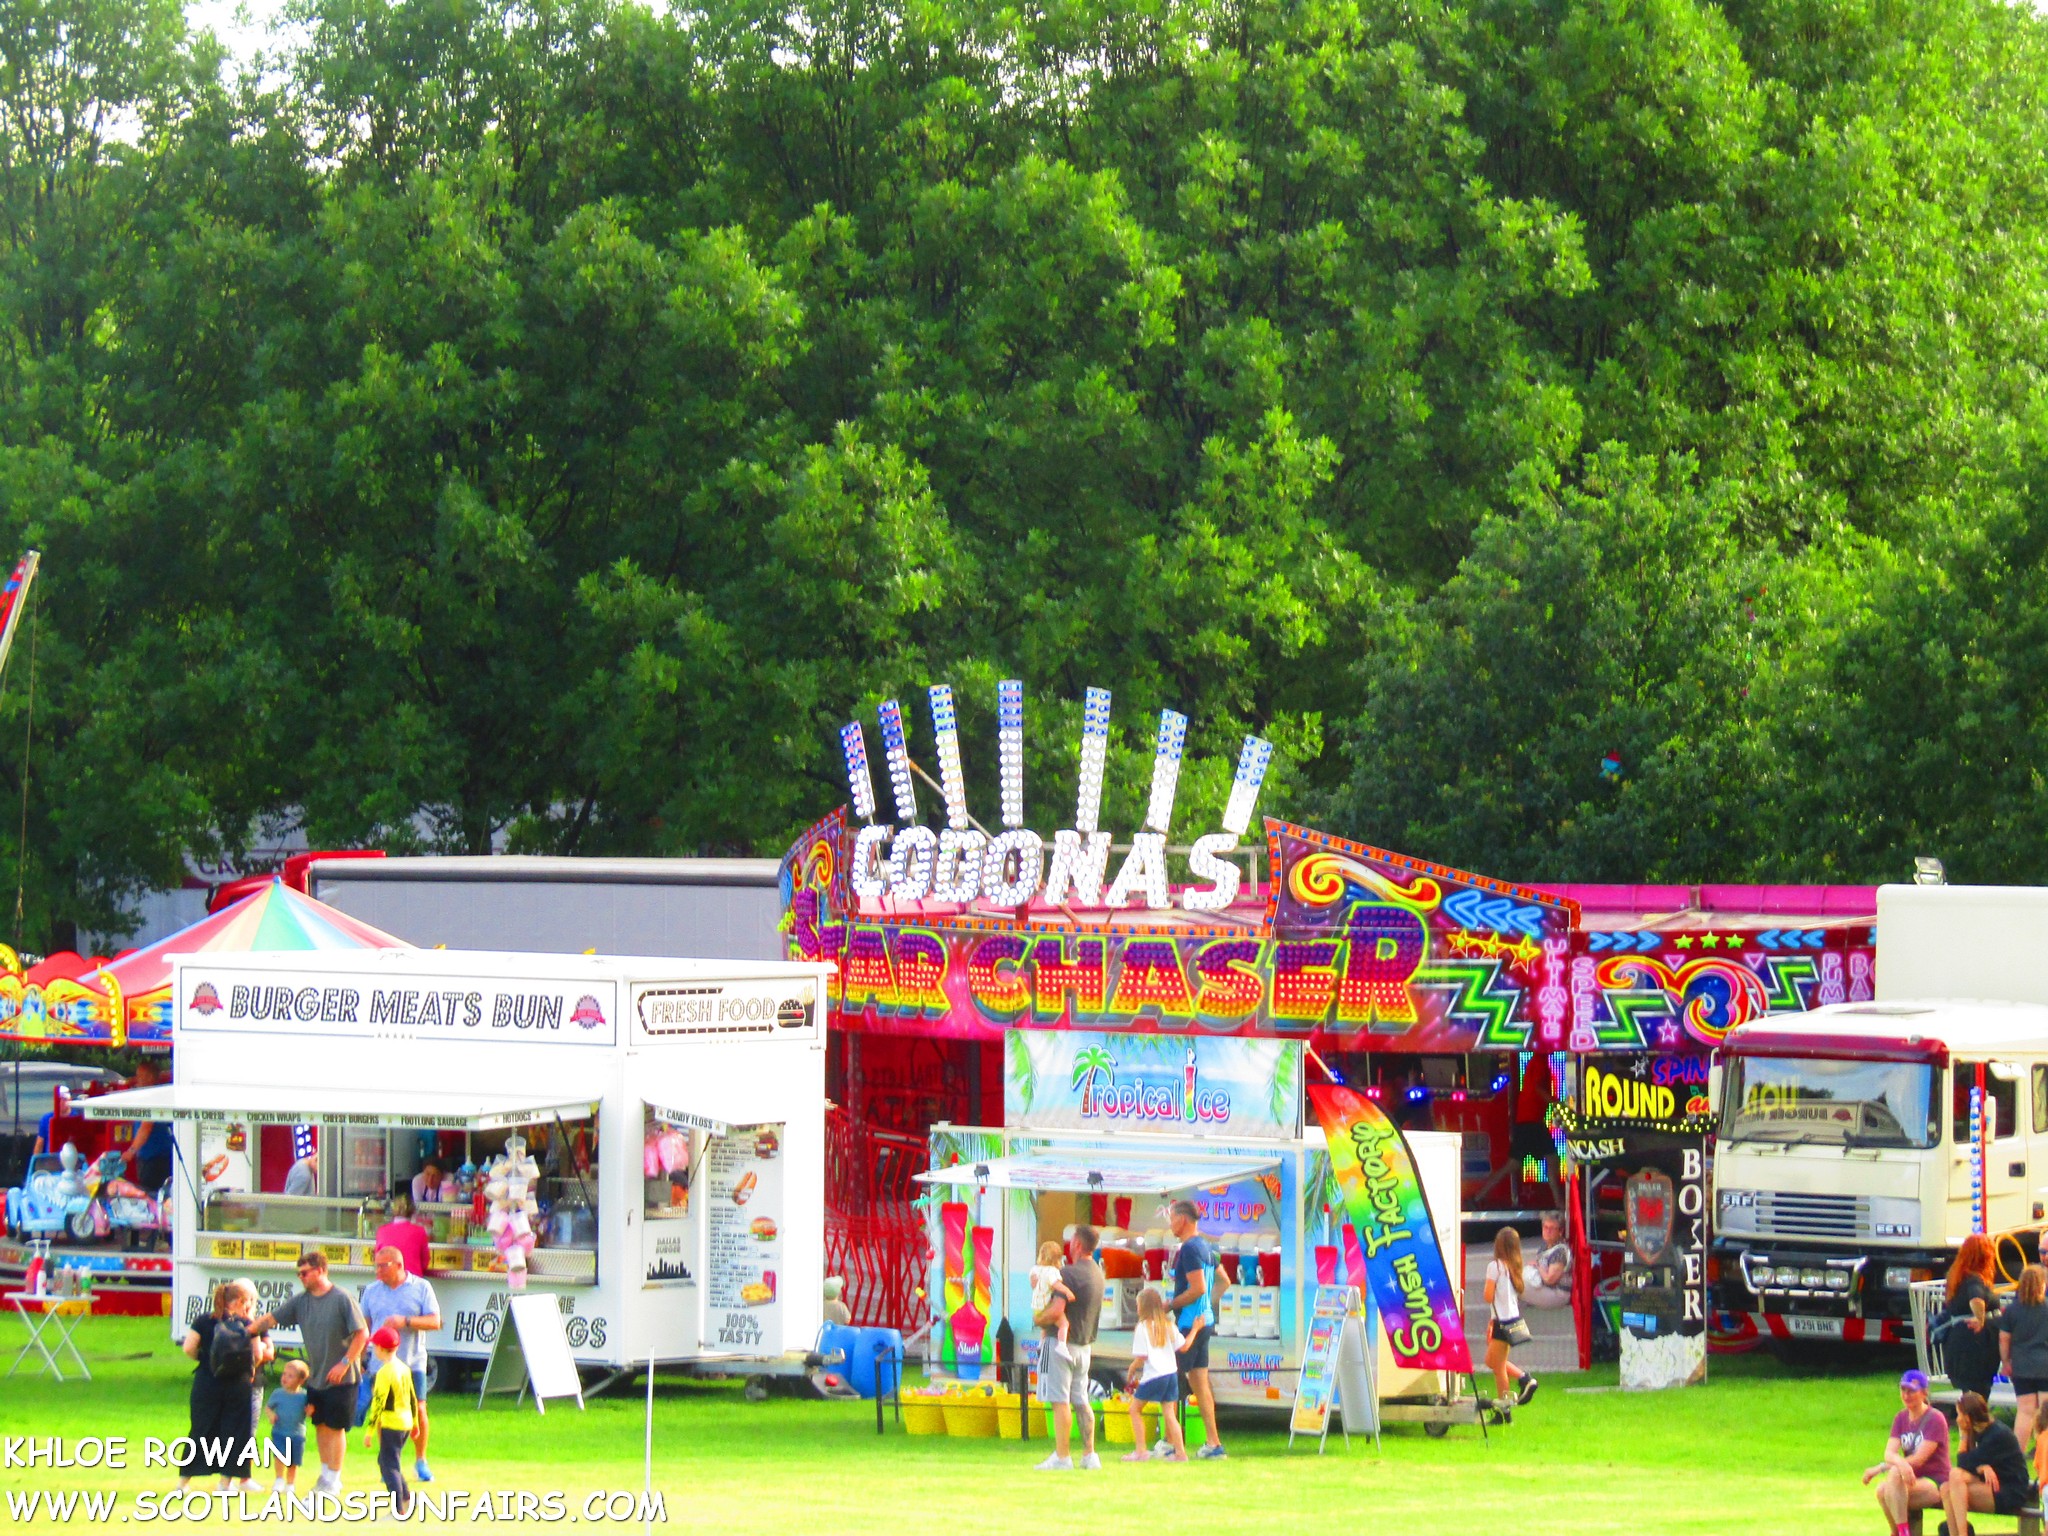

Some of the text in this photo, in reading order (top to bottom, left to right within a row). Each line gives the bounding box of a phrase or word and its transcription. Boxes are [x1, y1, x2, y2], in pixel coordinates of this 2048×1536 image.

[967, 901, 1429, 1026] CHASER
[230, 985, 563, 1030] BURGER MEATS BUN
[652, 997, 775, 1024] FRESH FOOD
[1570, 956, 1596, 1050] SPEED
[1585, 1065, 1675, 1119] ROUND
[92, 1107, 152, 1118] CHICKEN BURGERS
[172, 1109, 225, 1120] CHIPS & CHEESE
[246, 1111, 301, 1122] CHICKEN WRAPS
[322, 1112, 380, 1125] CHEESE BURGERS
[400, 1114, 468, 1127] FOOTLONG SAUSAGE
[502, 1111, 532, 1124] HOTDOGS
[666, 1109, 713, 1129] CANDY FLOSS
[1213, 1201, 1235, 1219] IT
[1238, 1203, 1266, 1221] UP
[726, 1313, 759, 1329] 100%
[718, 1328, 763, 1345] TASTY
[958, 1341, 979, 1355] Slush
[1227, 1351, 1284, 1371] MIX IT
